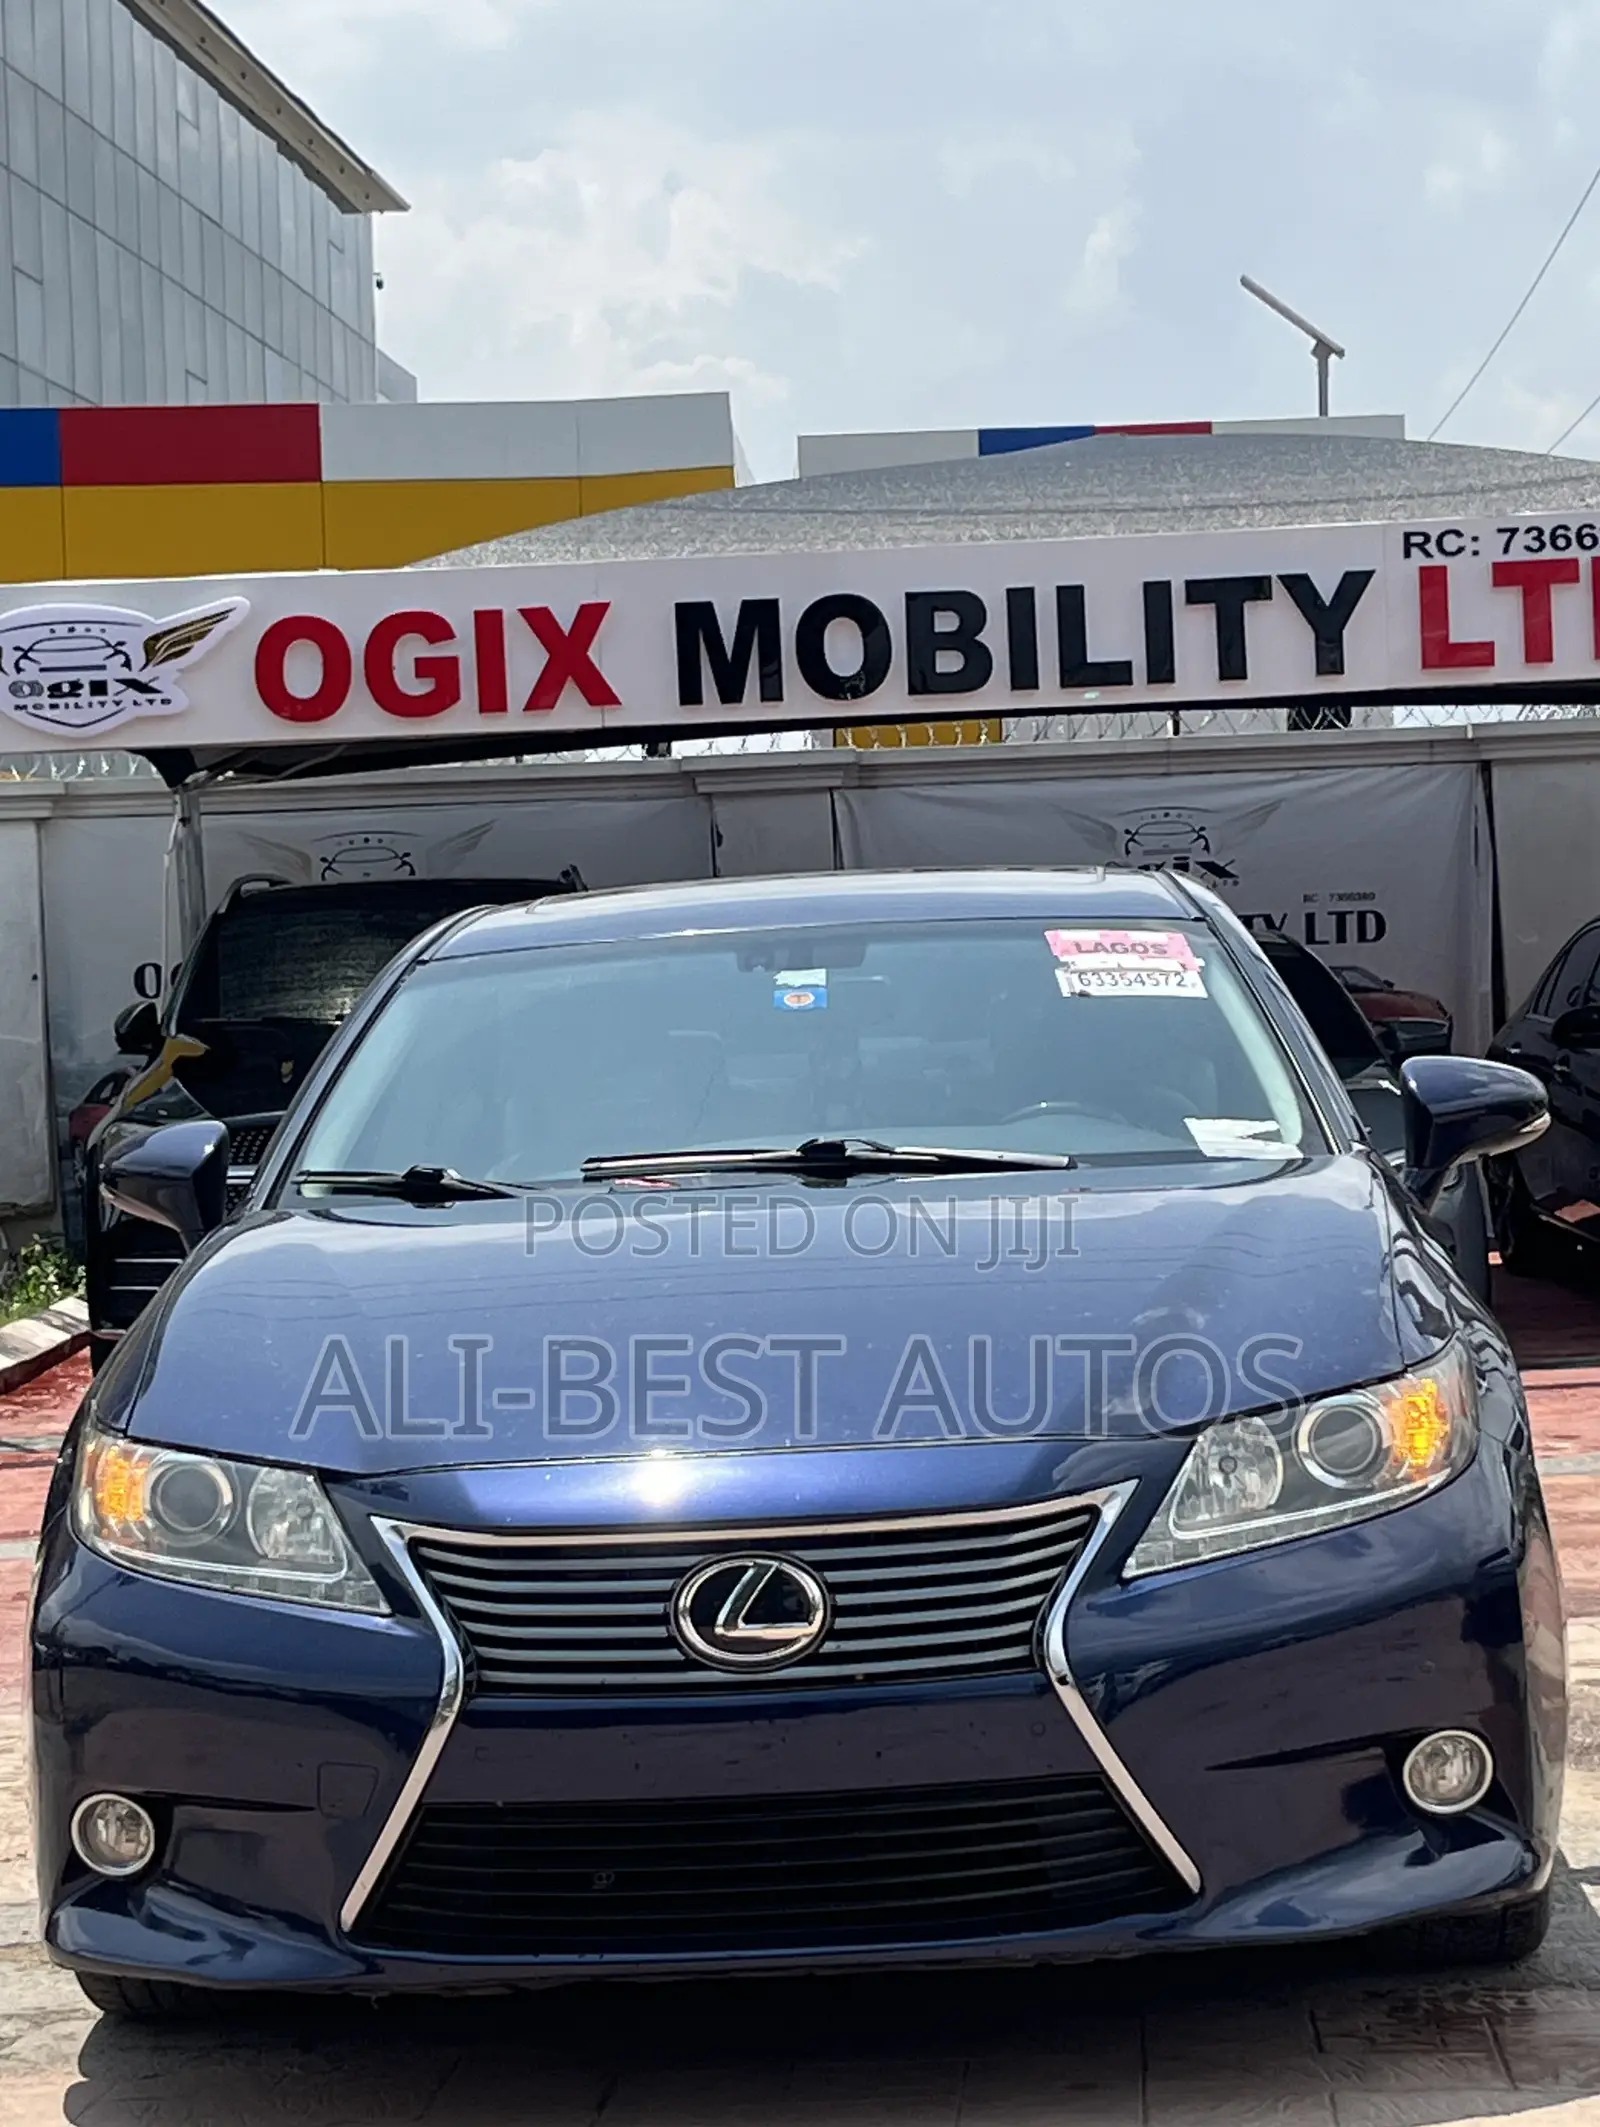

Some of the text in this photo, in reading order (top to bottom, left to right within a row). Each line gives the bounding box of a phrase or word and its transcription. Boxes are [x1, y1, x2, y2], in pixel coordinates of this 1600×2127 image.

[1403, 523, 1600, 559] RC: 7366
[255, 556, 1600, 722] OGIX MOBILITY LT
[14, 698, 172, 711] MOBILITY LTD
[1305, 909, 1386, 945] LTD
[1075, 942, 1168, 955] LAGOS
[1078, 971, 1188, 988] 63354572
